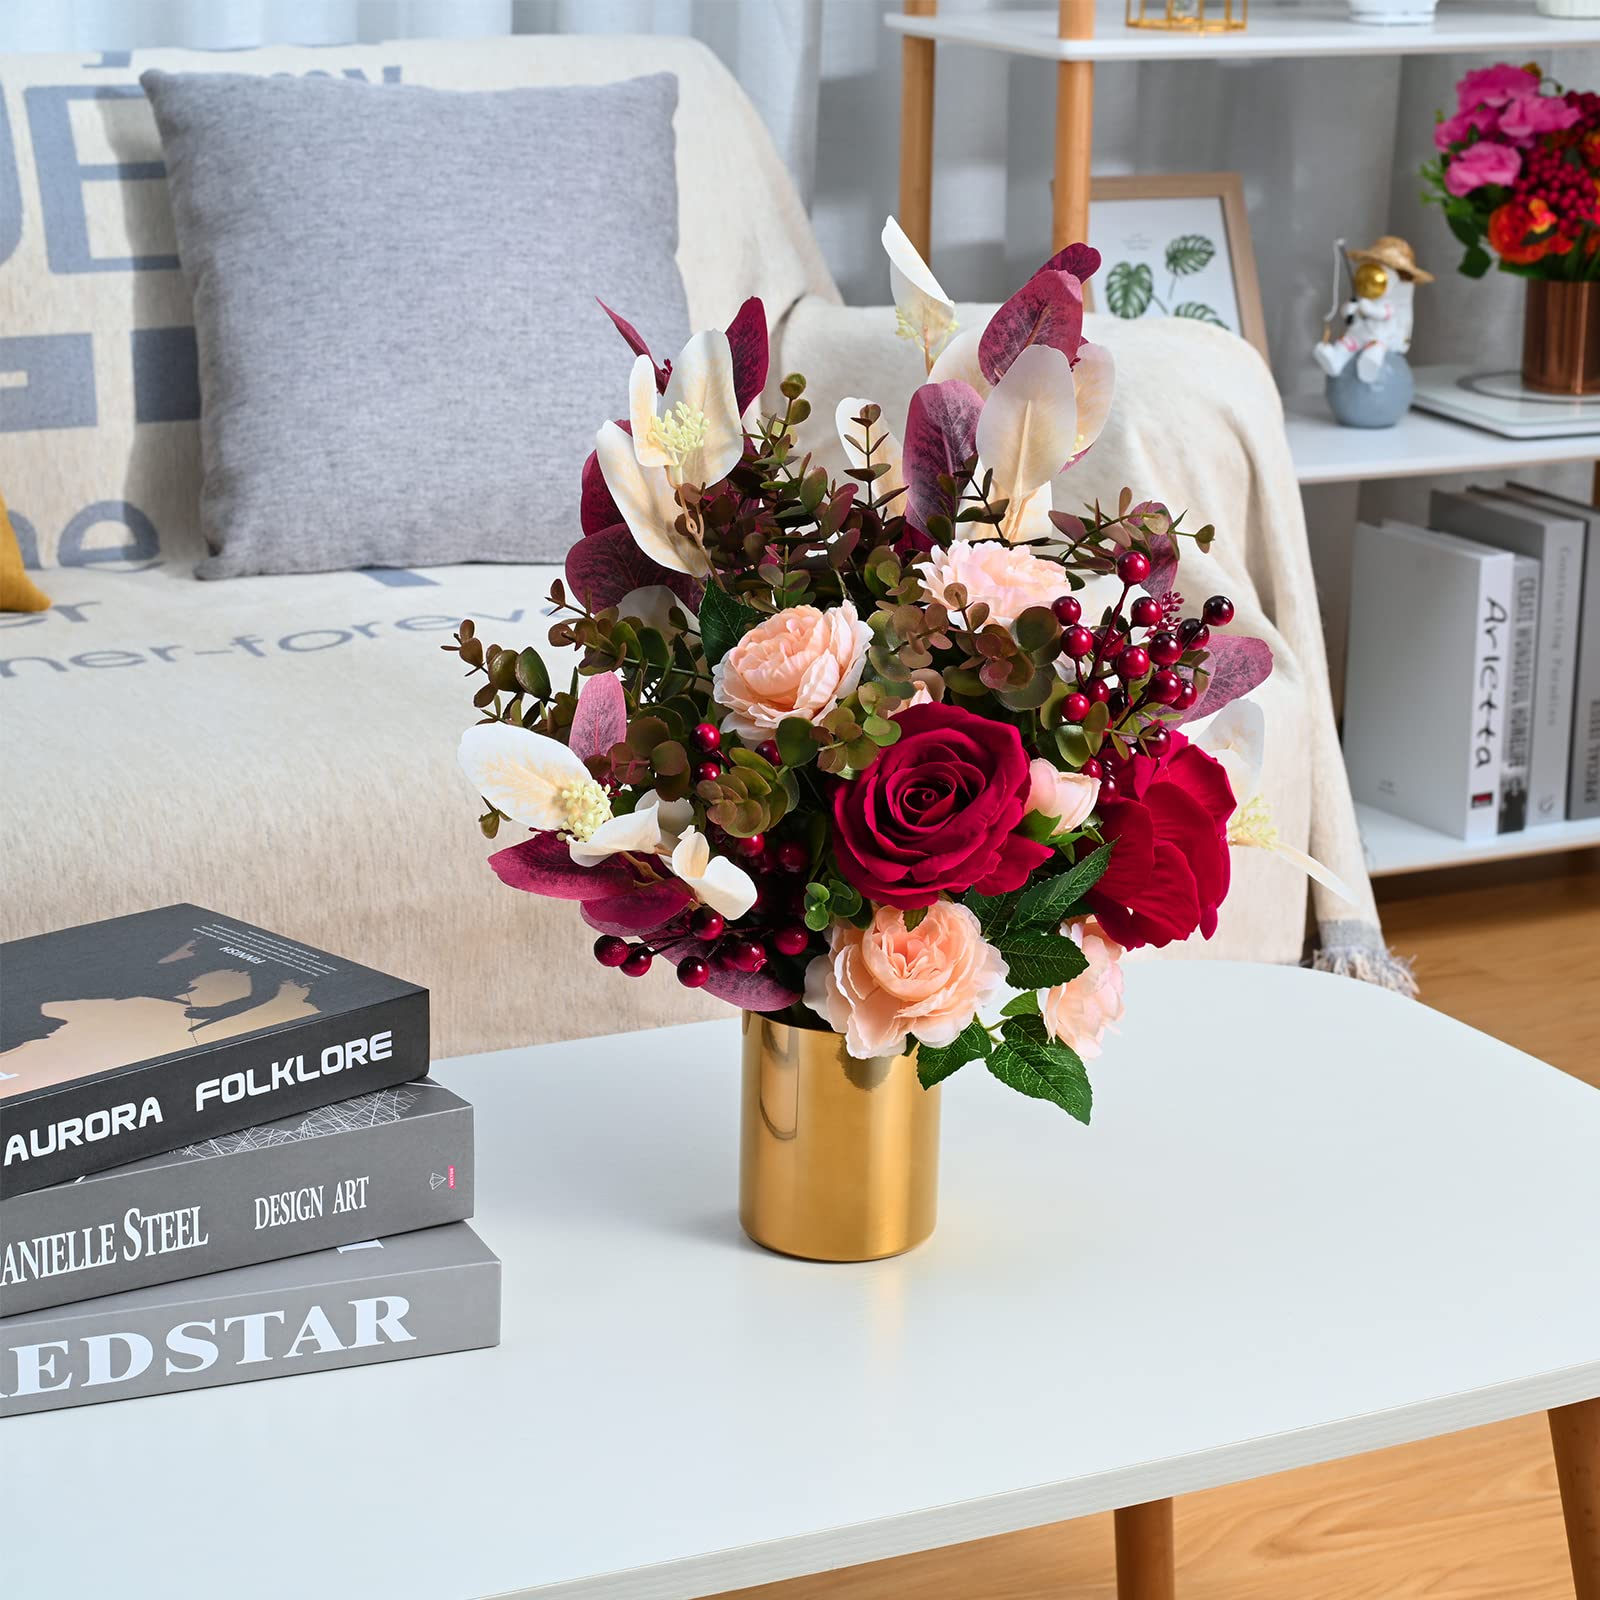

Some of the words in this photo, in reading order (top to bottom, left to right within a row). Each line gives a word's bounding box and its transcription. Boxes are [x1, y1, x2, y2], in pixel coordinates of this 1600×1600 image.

[3, 1096, 164, 1167] AURORA
[195, 1030, 393, 1112] FOLKLORE
[0, 1223, 117, 1287] ANIELLE
[122, 1206, 209, 1262] STEEL
[254, 1185, 324, 1230] DESIGN
[332, 1176, 370, 1214] ART
[0, 1295, 418, 1399] EDSTAR
